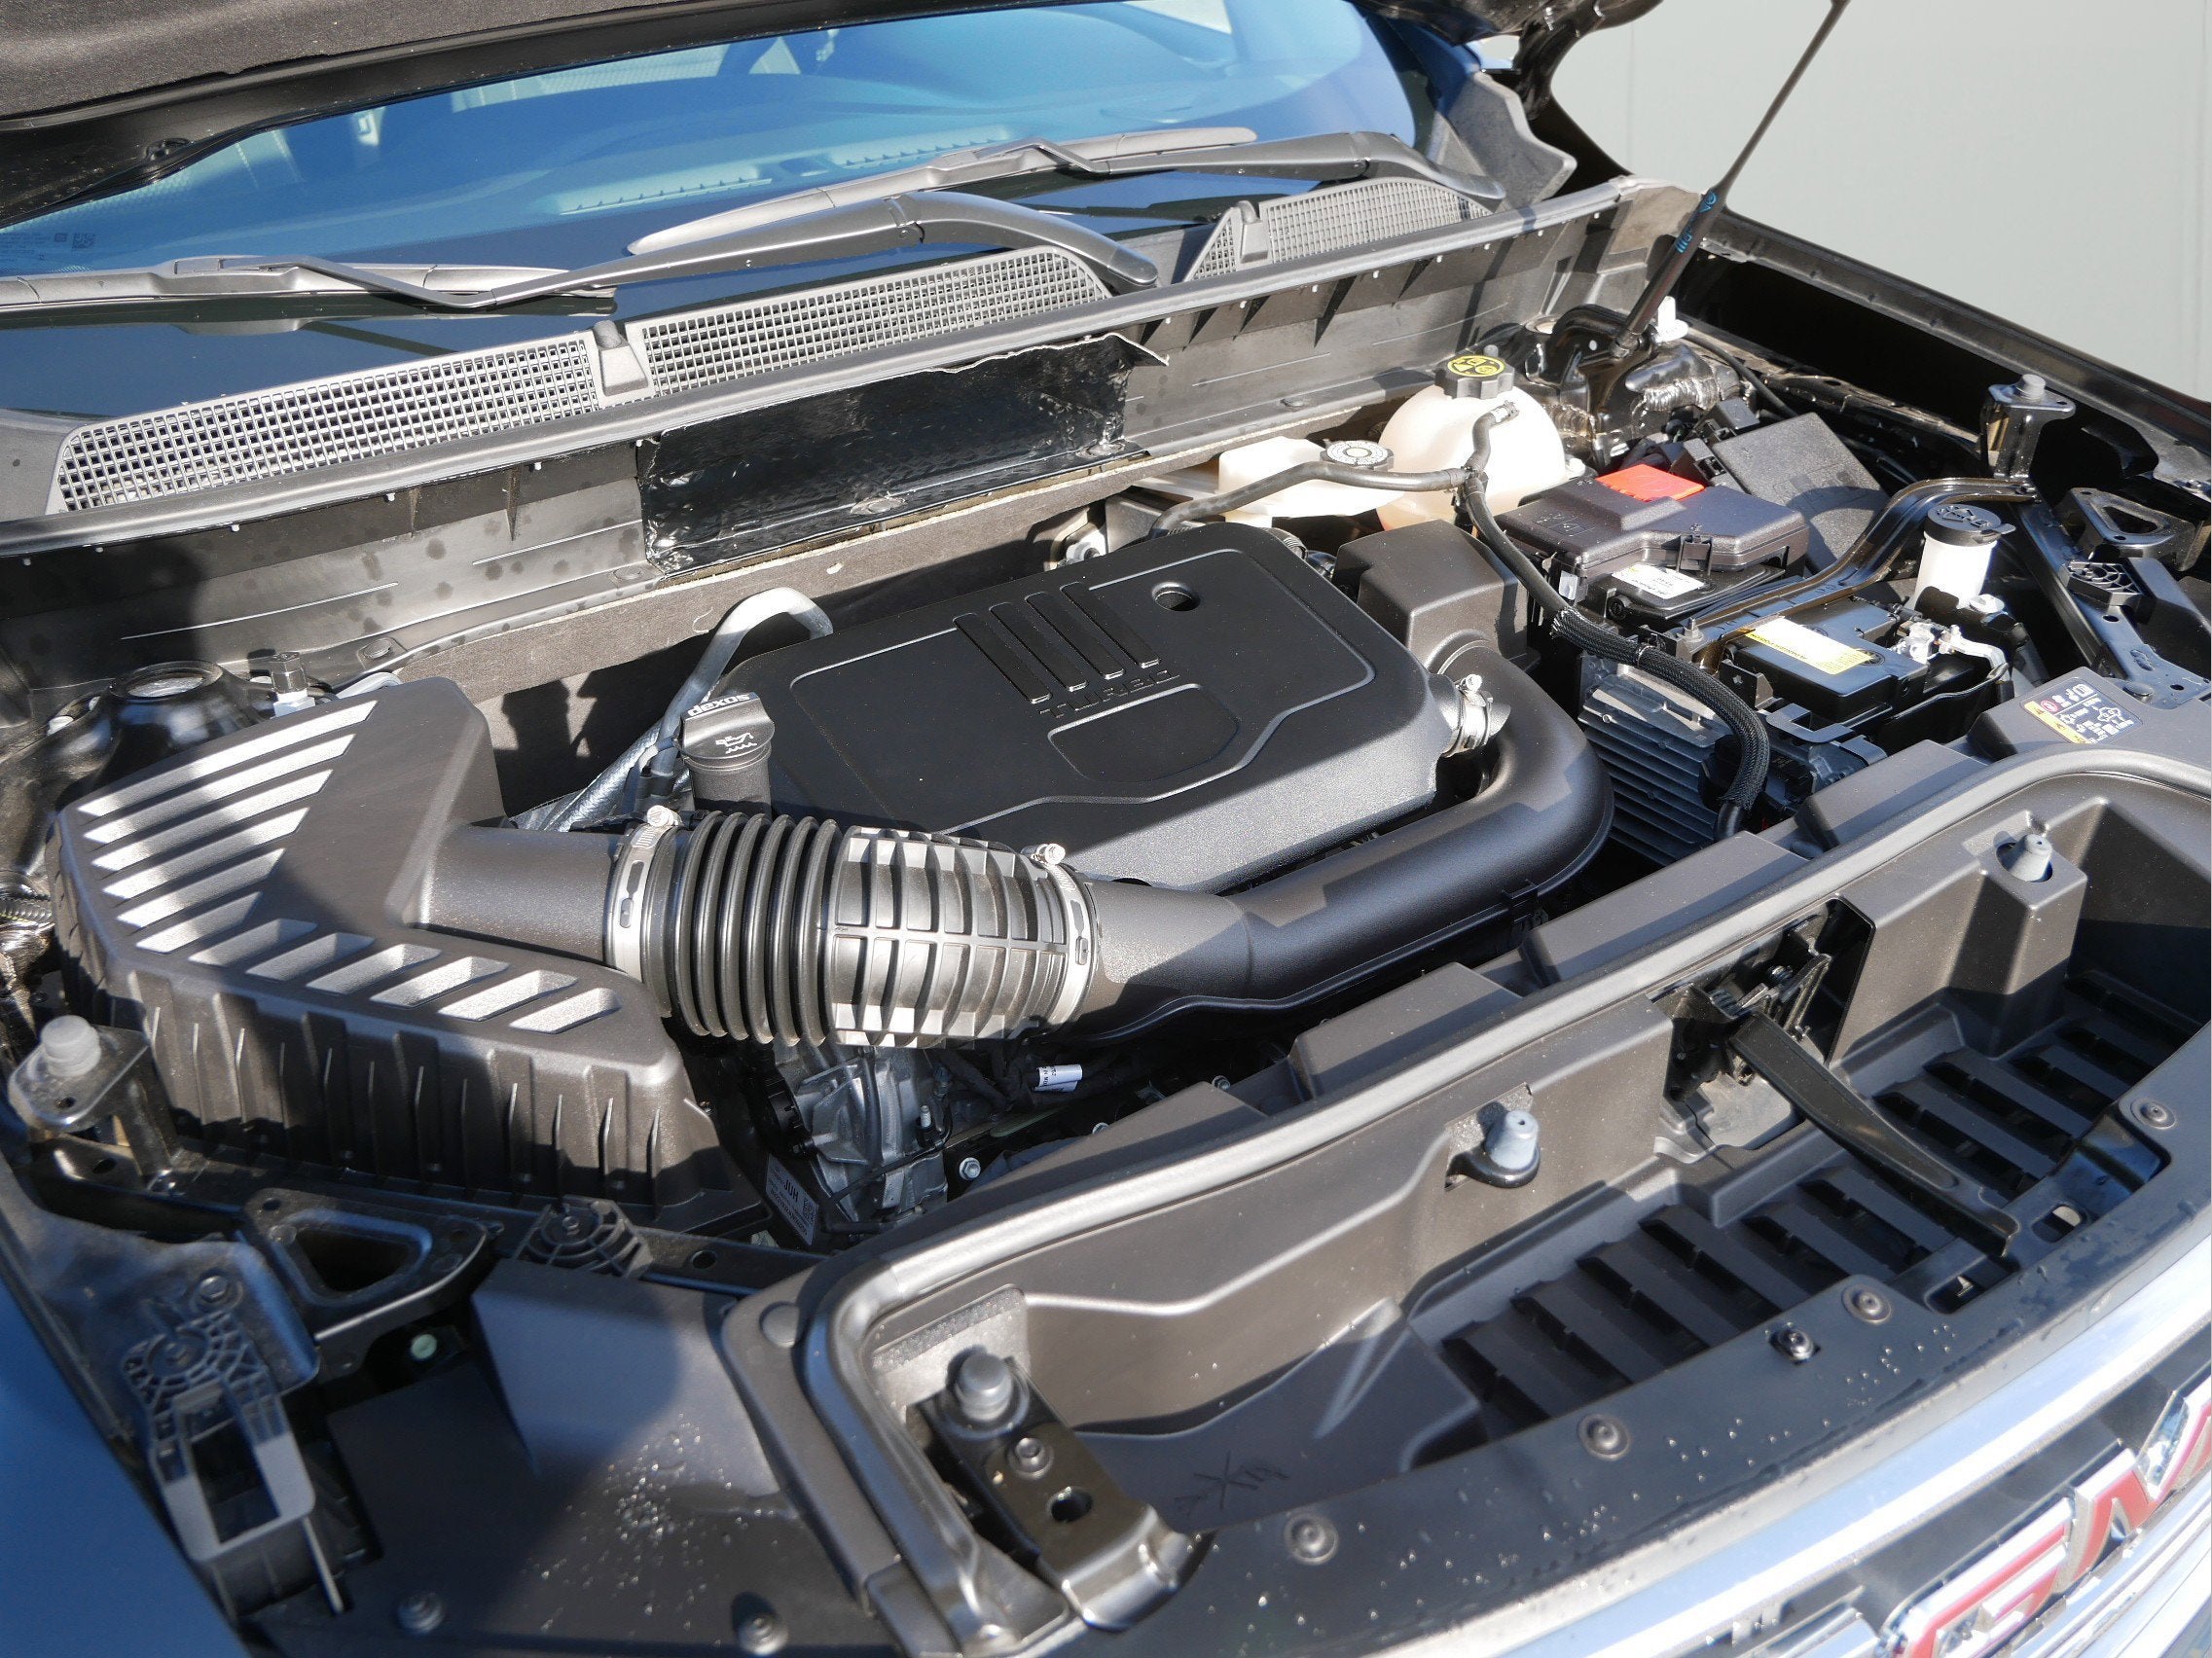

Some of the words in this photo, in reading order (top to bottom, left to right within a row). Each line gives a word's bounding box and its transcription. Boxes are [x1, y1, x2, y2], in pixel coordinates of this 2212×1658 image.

[687, 694, 750, 716] dexos
[1038, 669, 1180, 719] TURBO
[783, 1179, 799, 1203] JUH
